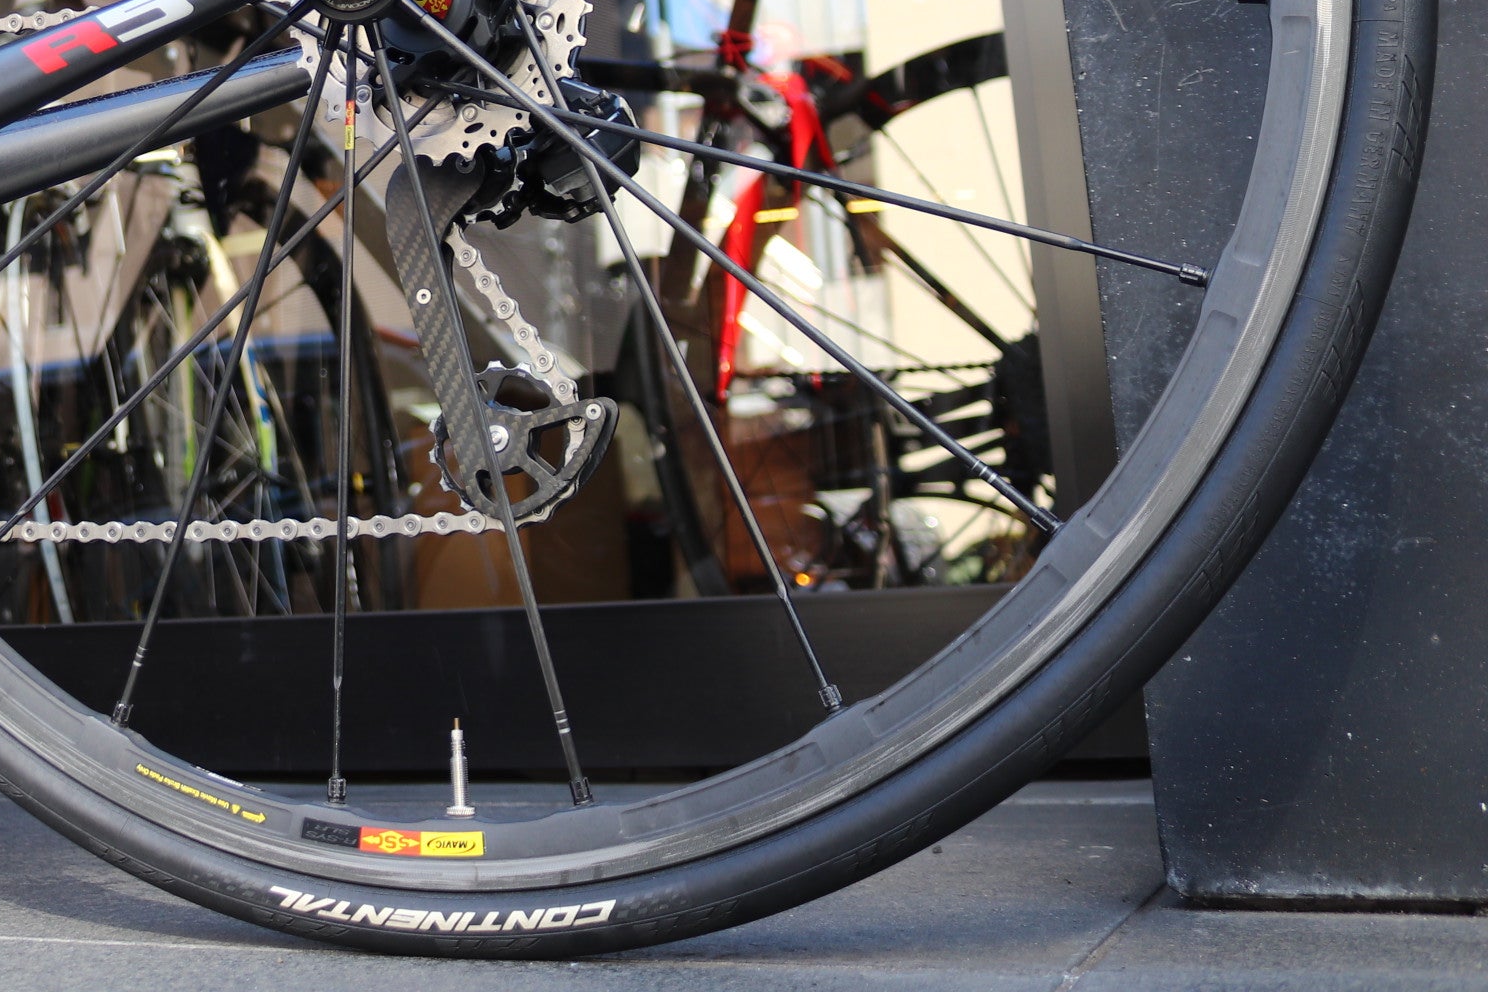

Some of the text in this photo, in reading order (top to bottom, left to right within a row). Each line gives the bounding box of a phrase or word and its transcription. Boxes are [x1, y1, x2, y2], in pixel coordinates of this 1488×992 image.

[1372, 30, 1400, 91] MADE
[1368, 98, 1393, 123] IN
[269, 884, 617, 932] CONTINENTAL
